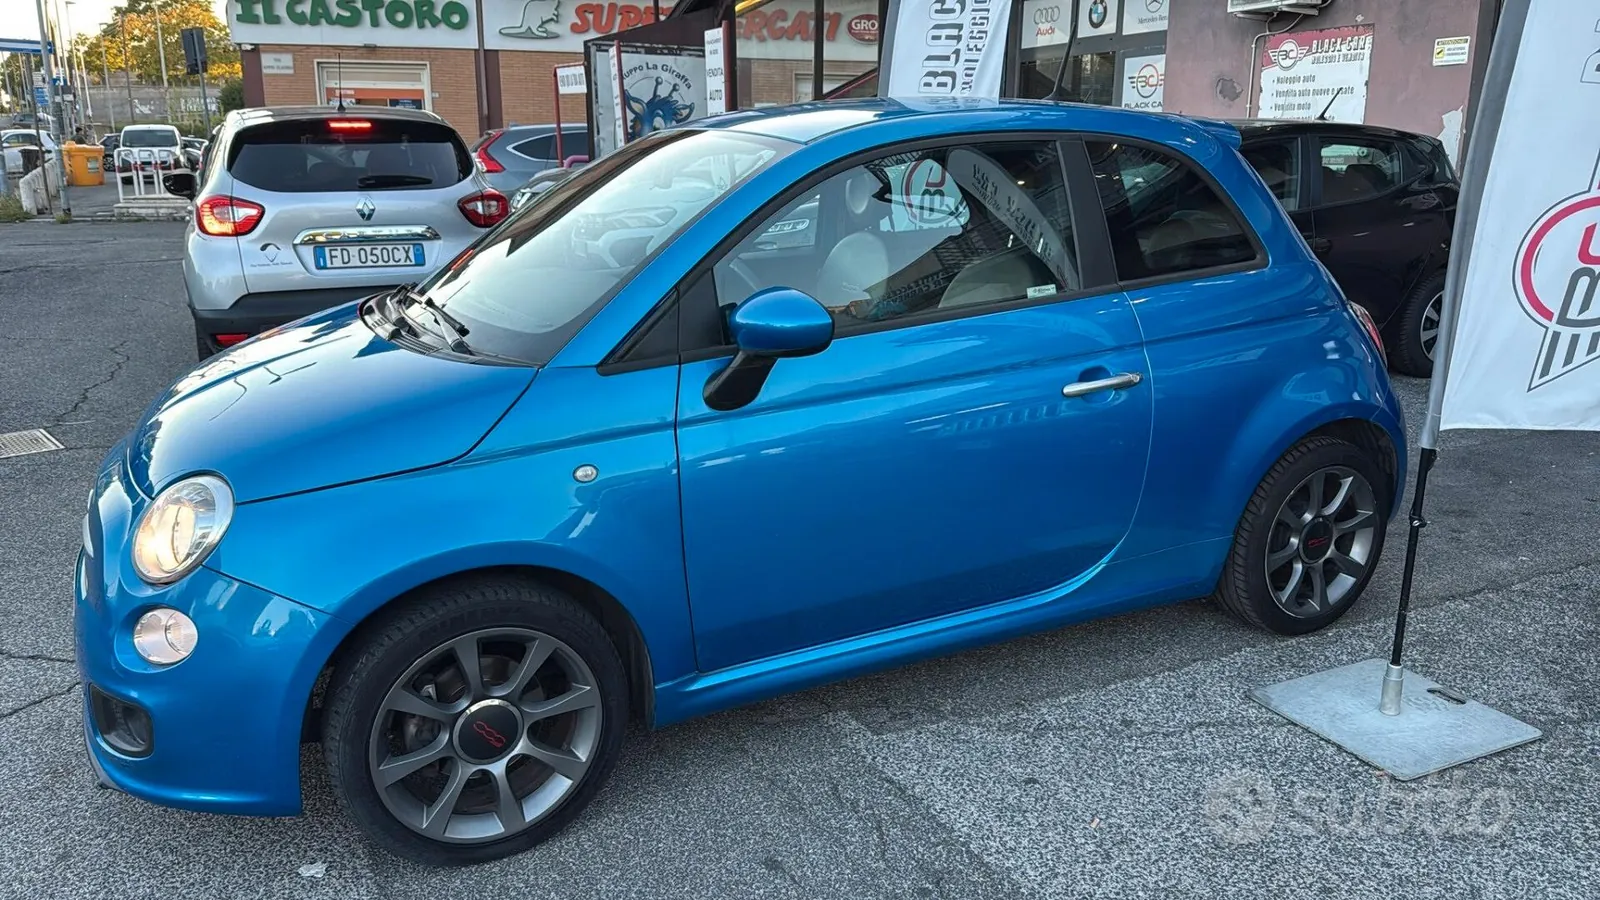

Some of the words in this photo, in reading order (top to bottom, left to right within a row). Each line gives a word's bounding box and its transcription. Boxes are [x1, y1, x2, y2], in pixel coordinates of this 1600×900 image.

[236, 0, 281, 24] IL
[286, 0, 469, 30] CASTORO
[1036, 26, 1055, 37] Audi
[1311, 38, 1343, 54] BLACK
[1346, 36, 1366, 52] CAR
[645, 61, 658, 71] La
[661, 63, 692, 90] Giraffa
[1276, 74, 1301, 85] Noleggio
[1302, 74, 1316, 83] auto
[1275, 89, 1297, 98] Vendita
[1298, 88, 1311, 97] auto
[1312, 87, 1330, 96] nuove
[1297, 101, 1312, 111] moto
[328, 248, 351, 266] FD
[358, 245, 414, 265] 050CX
